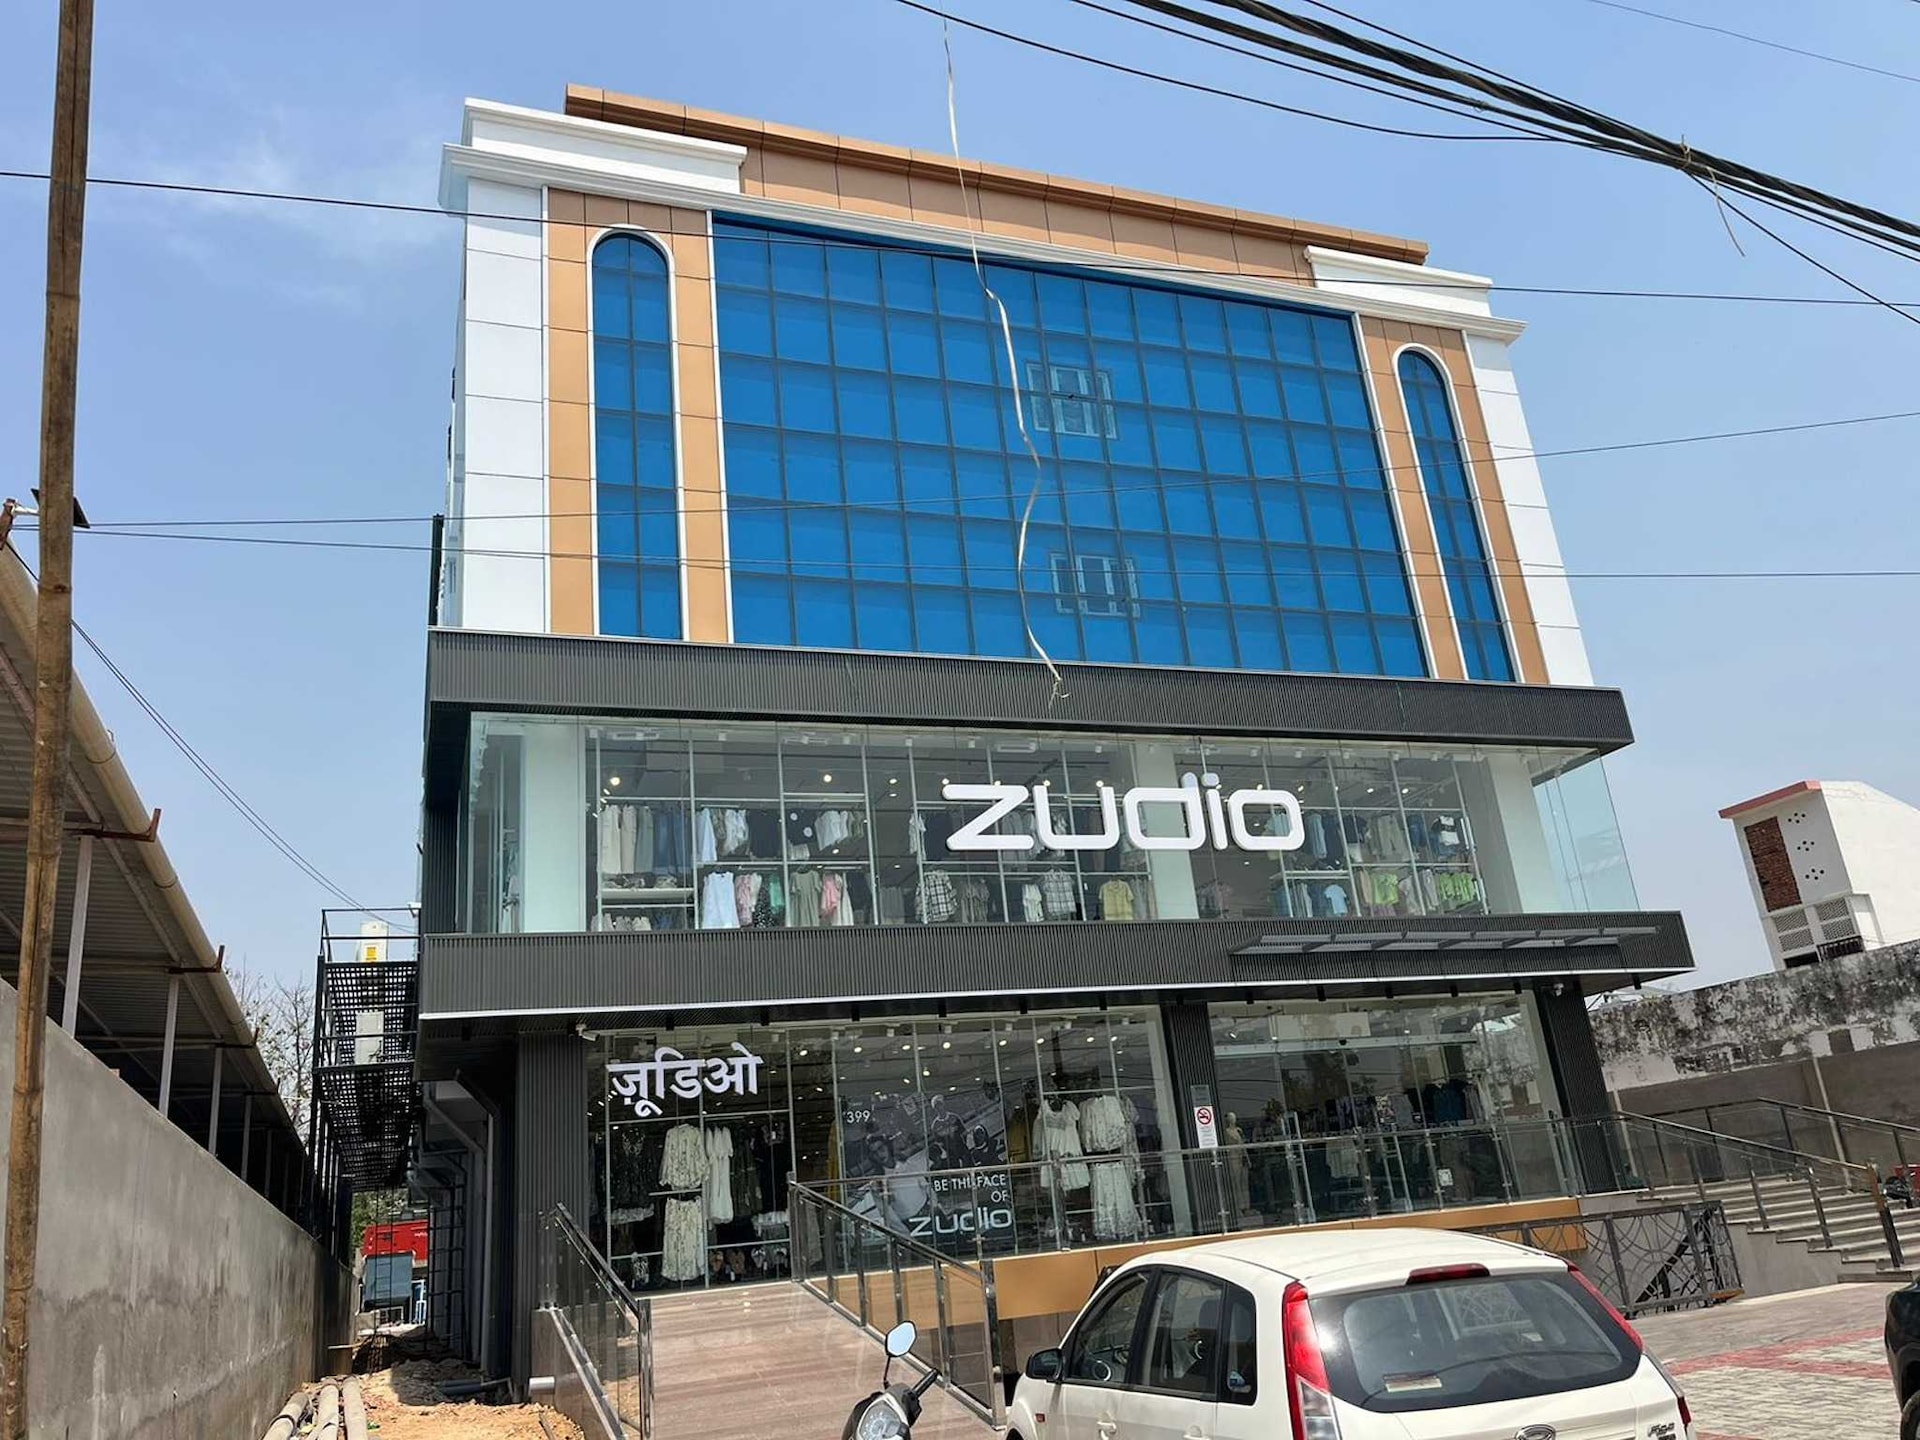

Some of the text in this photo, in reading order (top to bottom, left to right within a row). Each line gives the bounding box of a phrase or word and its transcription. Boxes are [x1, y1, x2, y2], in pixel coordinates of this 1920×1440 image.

[942, 772, 1305, 851] zudio
[605, 1042, 764, 1117] ज़ूडिओ
[933, 1179, 948, 1192] BE
[977, 1174, 1007, 1188] FACE
[991, 1190, 1009, 1203] OF
